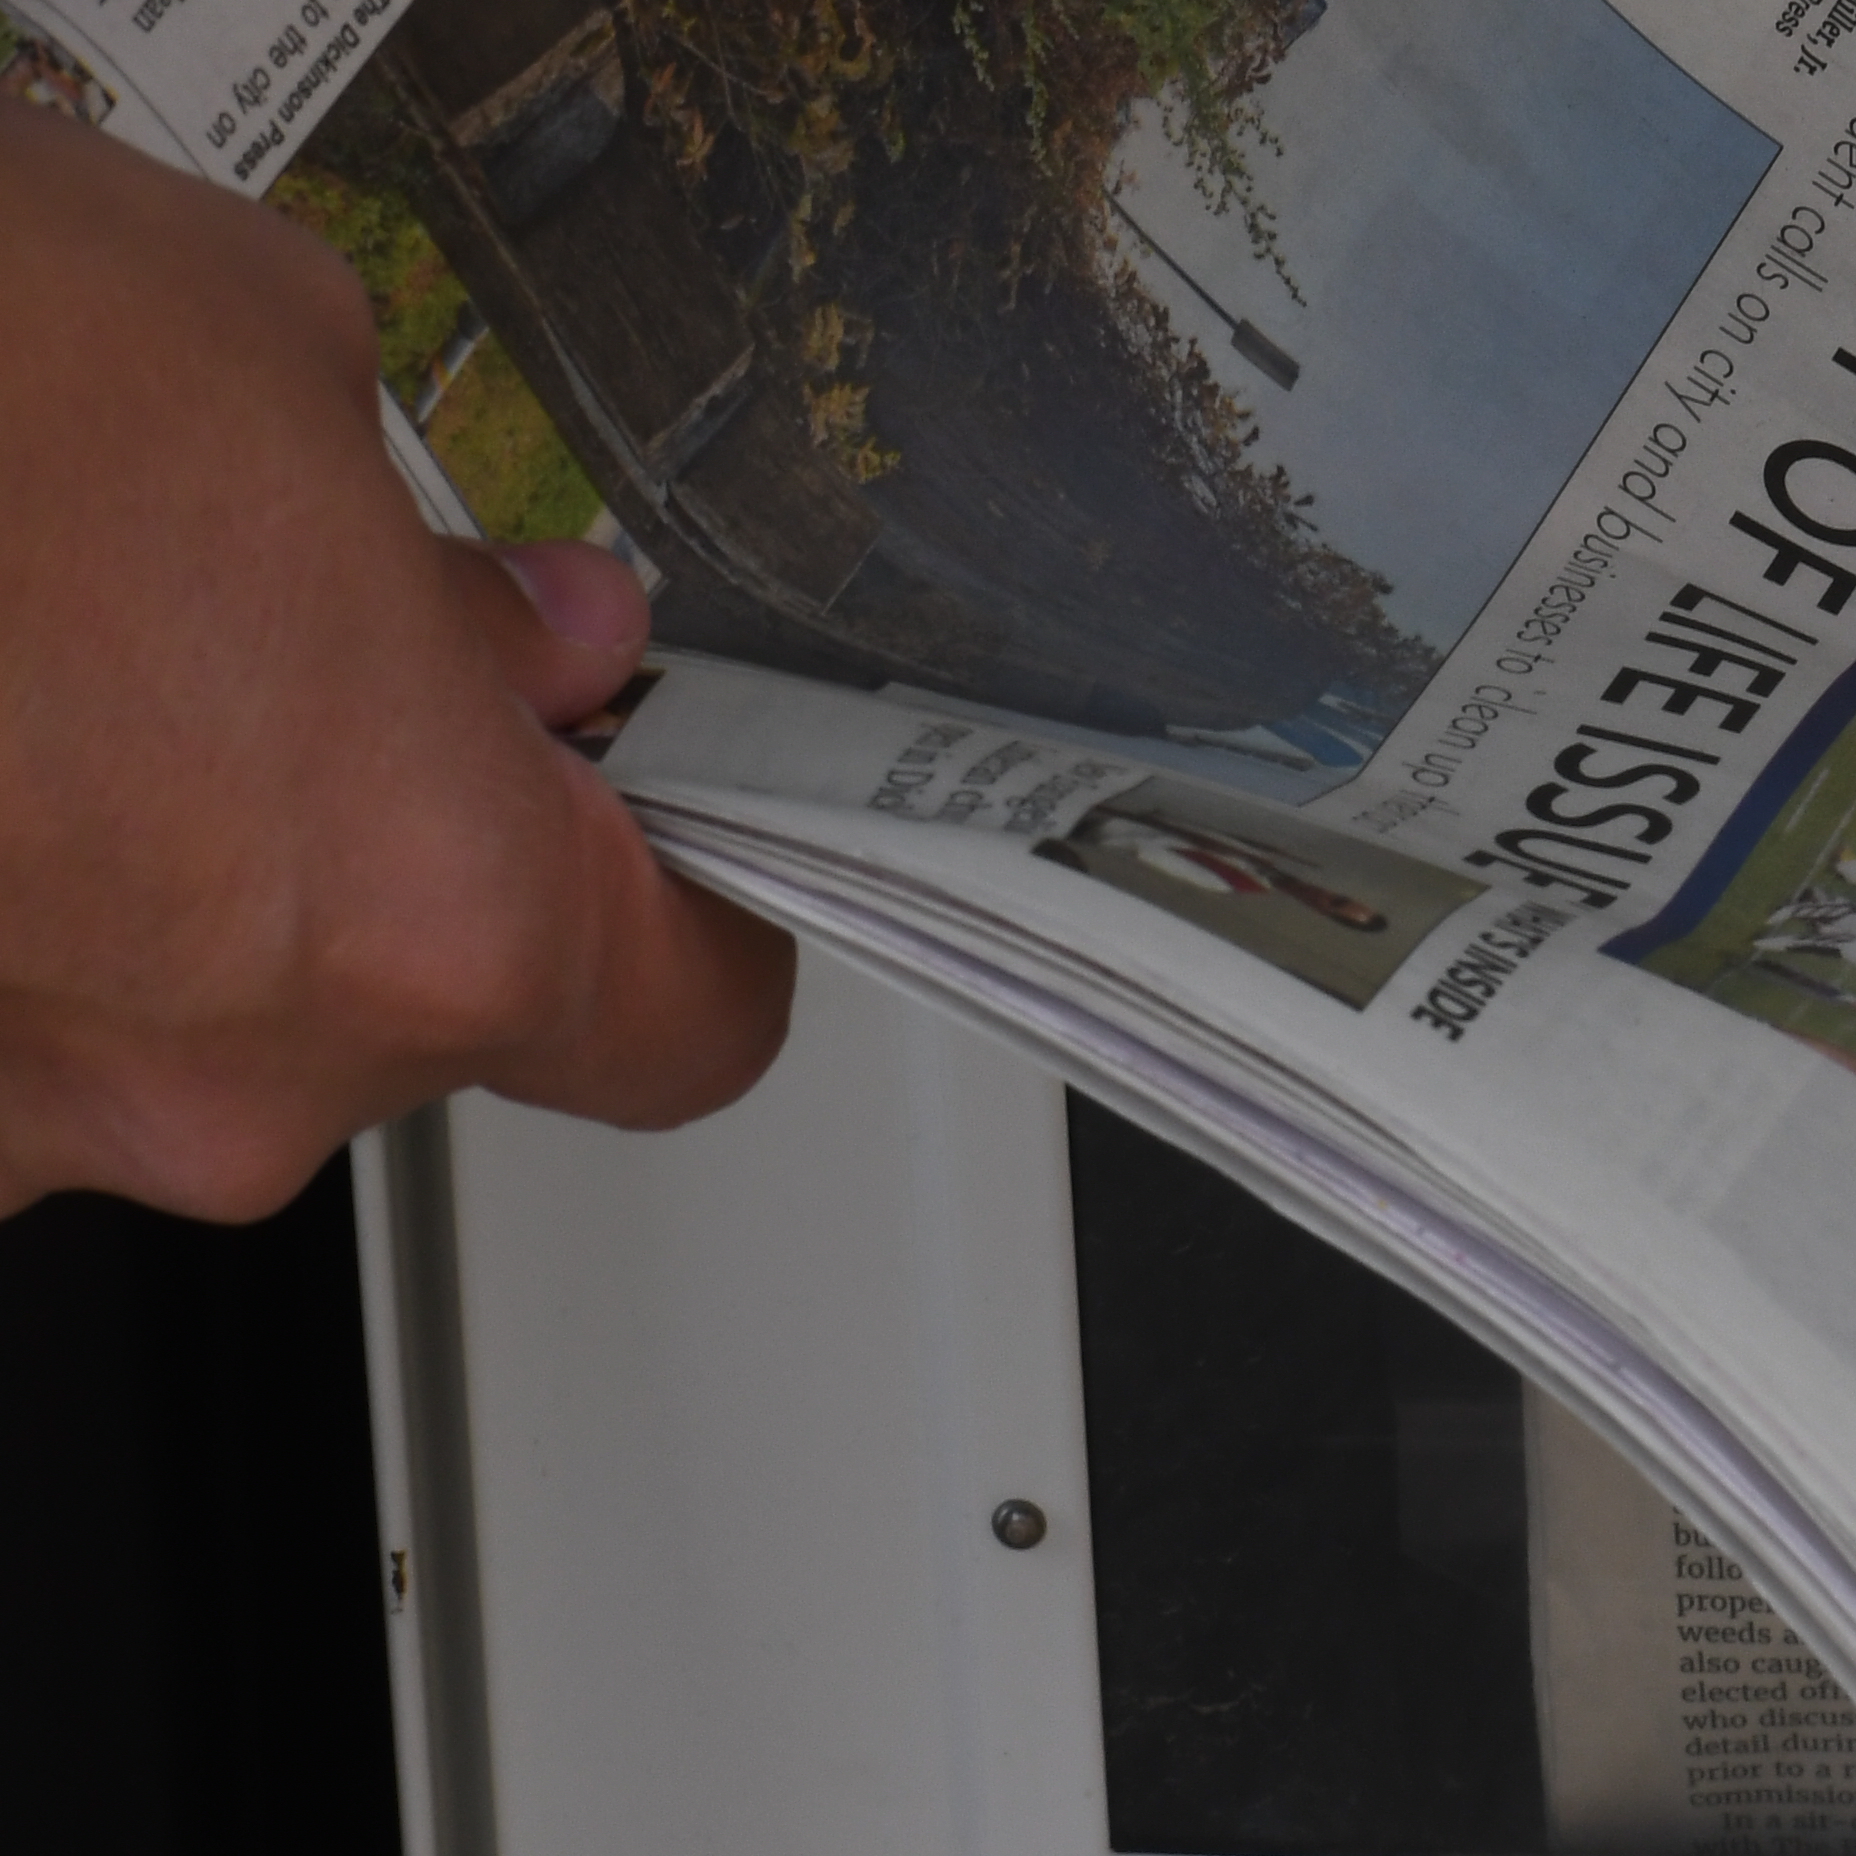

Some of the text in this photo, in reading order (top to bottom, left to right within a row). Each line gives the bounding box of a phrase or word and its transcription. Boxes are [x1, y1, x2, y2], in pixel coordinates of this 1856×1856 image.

[267, 23, 308, 69] the
[276, 21, 361, 124] Dickinson
[1792, 43, 1828, 76] Jr.
[231, 66, 271, 115] city
[205, 111, 237, 149] on
[232, 118, 286, 182] Press
[1755, 205, 1829, 293] calls
[1718, 292, 1770, 345] on
[1663, 348, 1737, 424] city
[1616, 422, 1687, 523] and
[1599, 581, 1819, 734] LIFE
[1409, 944, 1519, 1043] INSIDE
[1675, 1620, 1772, 1645] weeds
[1678, 1649, 1740, 1674] also
